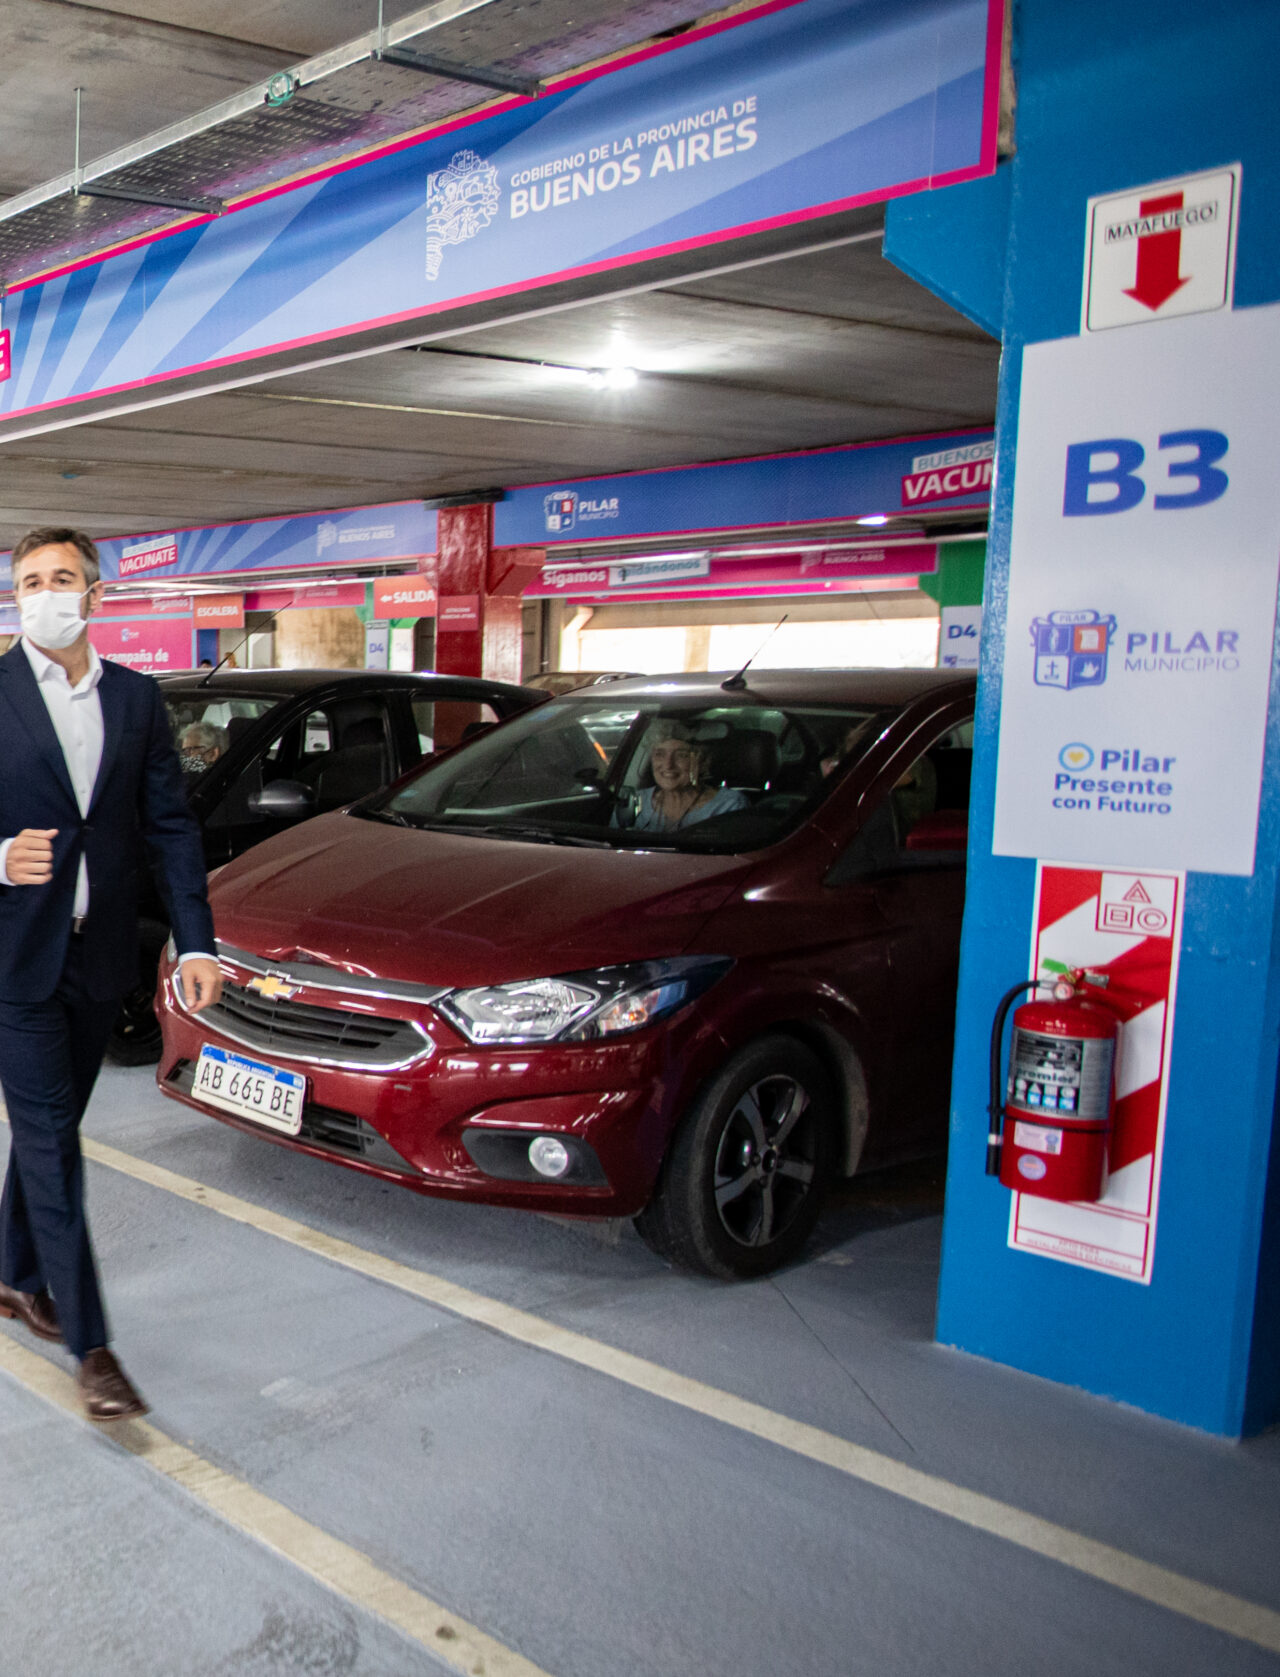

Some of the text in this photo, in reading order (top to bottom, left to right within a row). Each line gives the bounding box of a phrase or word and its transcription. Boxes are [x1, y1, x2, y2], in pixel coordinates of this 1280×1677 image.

[510, 95, 757, 188] GOBIERNO DE LA PROVINCIA DE
[510, 116, 758, 219] BUENOS AIRES
[1107, 205, 1215, 242] MATAFUEGO
[918, 442, 994, 470] BUENOS
[1063, 428, 1229, 517] B3
[579, 497, 619, 513] PILAR
[119, 546, 177, 575] VACUNATE
[393, 589, 436, 604] SALIDA
[197, 606, 239, 617] ESCALERA
[1059, 613, 1087, 623] PILAR
[948, 624, 977, 639] D4
[1126, 630, 1240, 654] PILAR
[106, 648, 169, 667] campaña de
[1124, 656, 1241, 672] MUNICIPIO
[1100, 749, 1176, 774] Pilar
[1054, 773, 1173, 797] Presente
[1052, 795, 1172, 815] con Futuro
[200, 1062, 296, 1117] AB 665 BE
